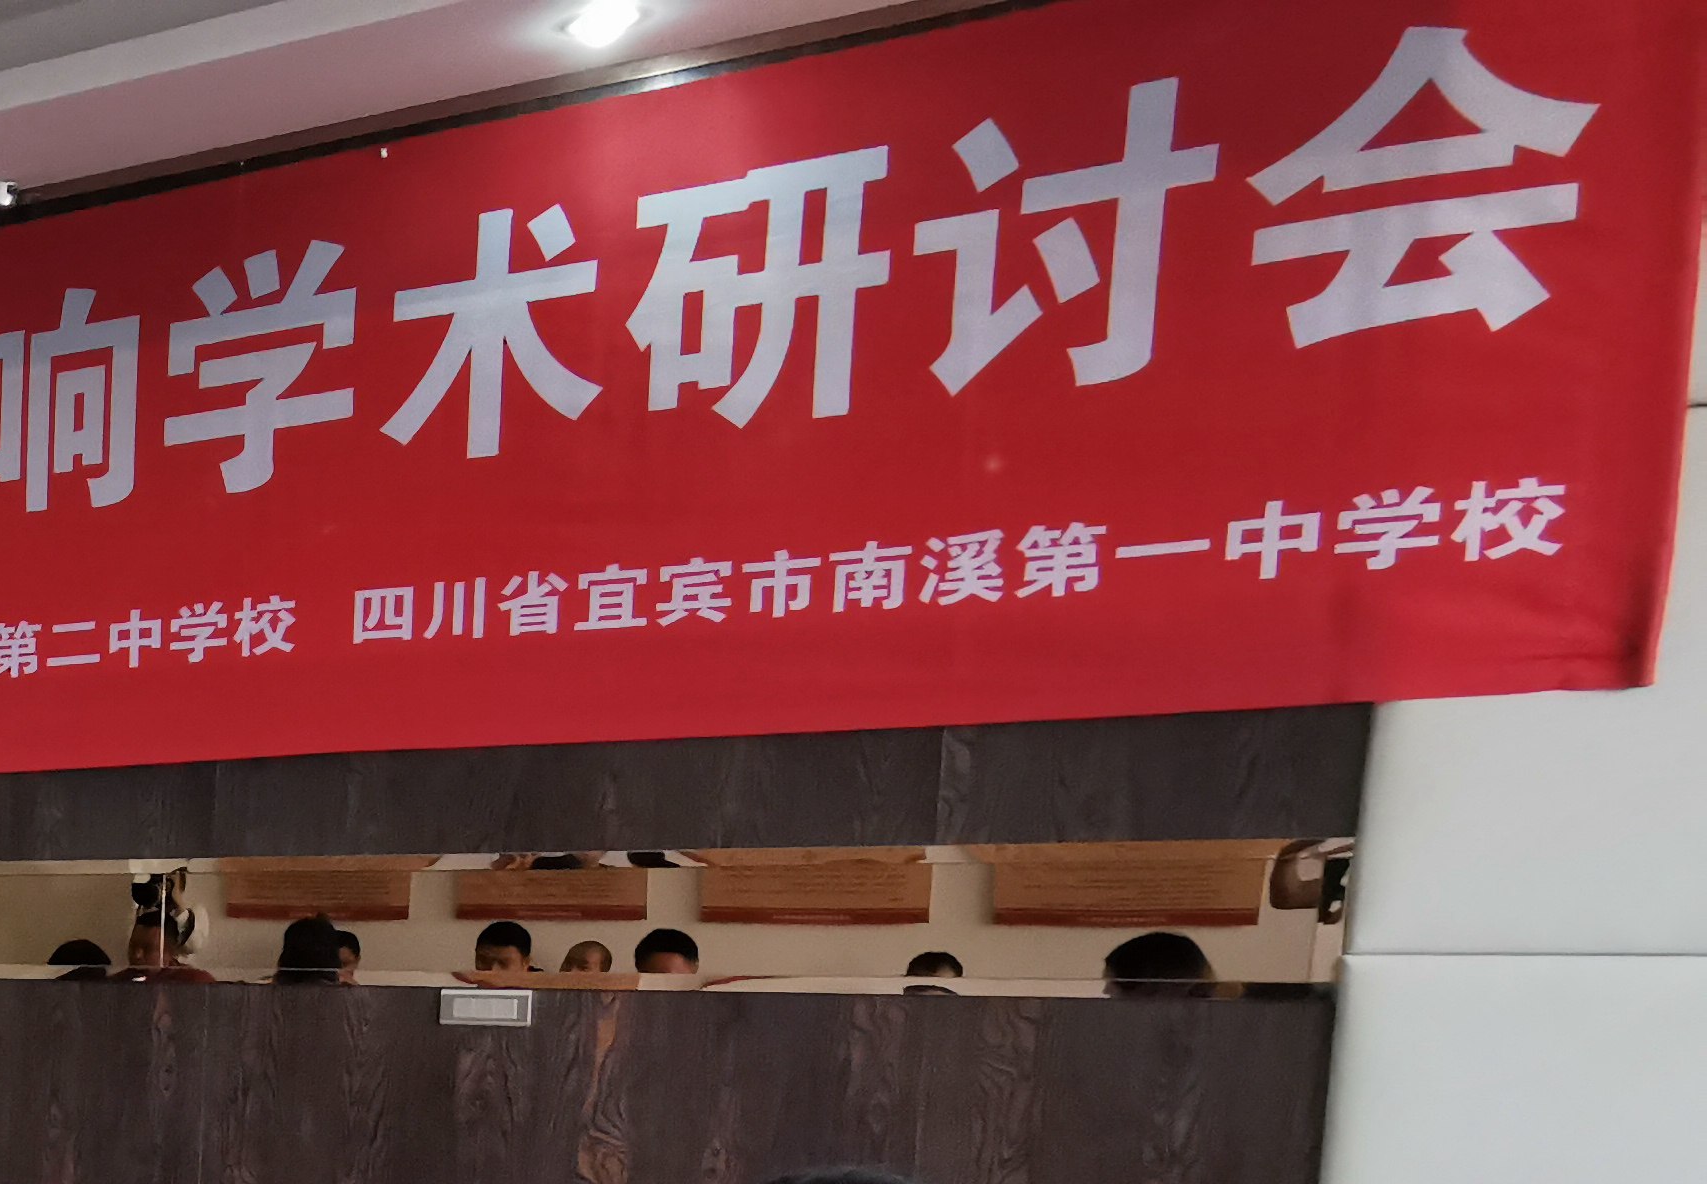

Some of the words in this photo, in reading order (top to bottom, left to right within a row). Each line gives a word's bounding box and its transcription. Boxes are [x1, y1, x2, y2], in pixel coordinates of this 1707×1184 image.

[351, 478, 1567, 645] 四川省宜宾市南溪第一中学校
